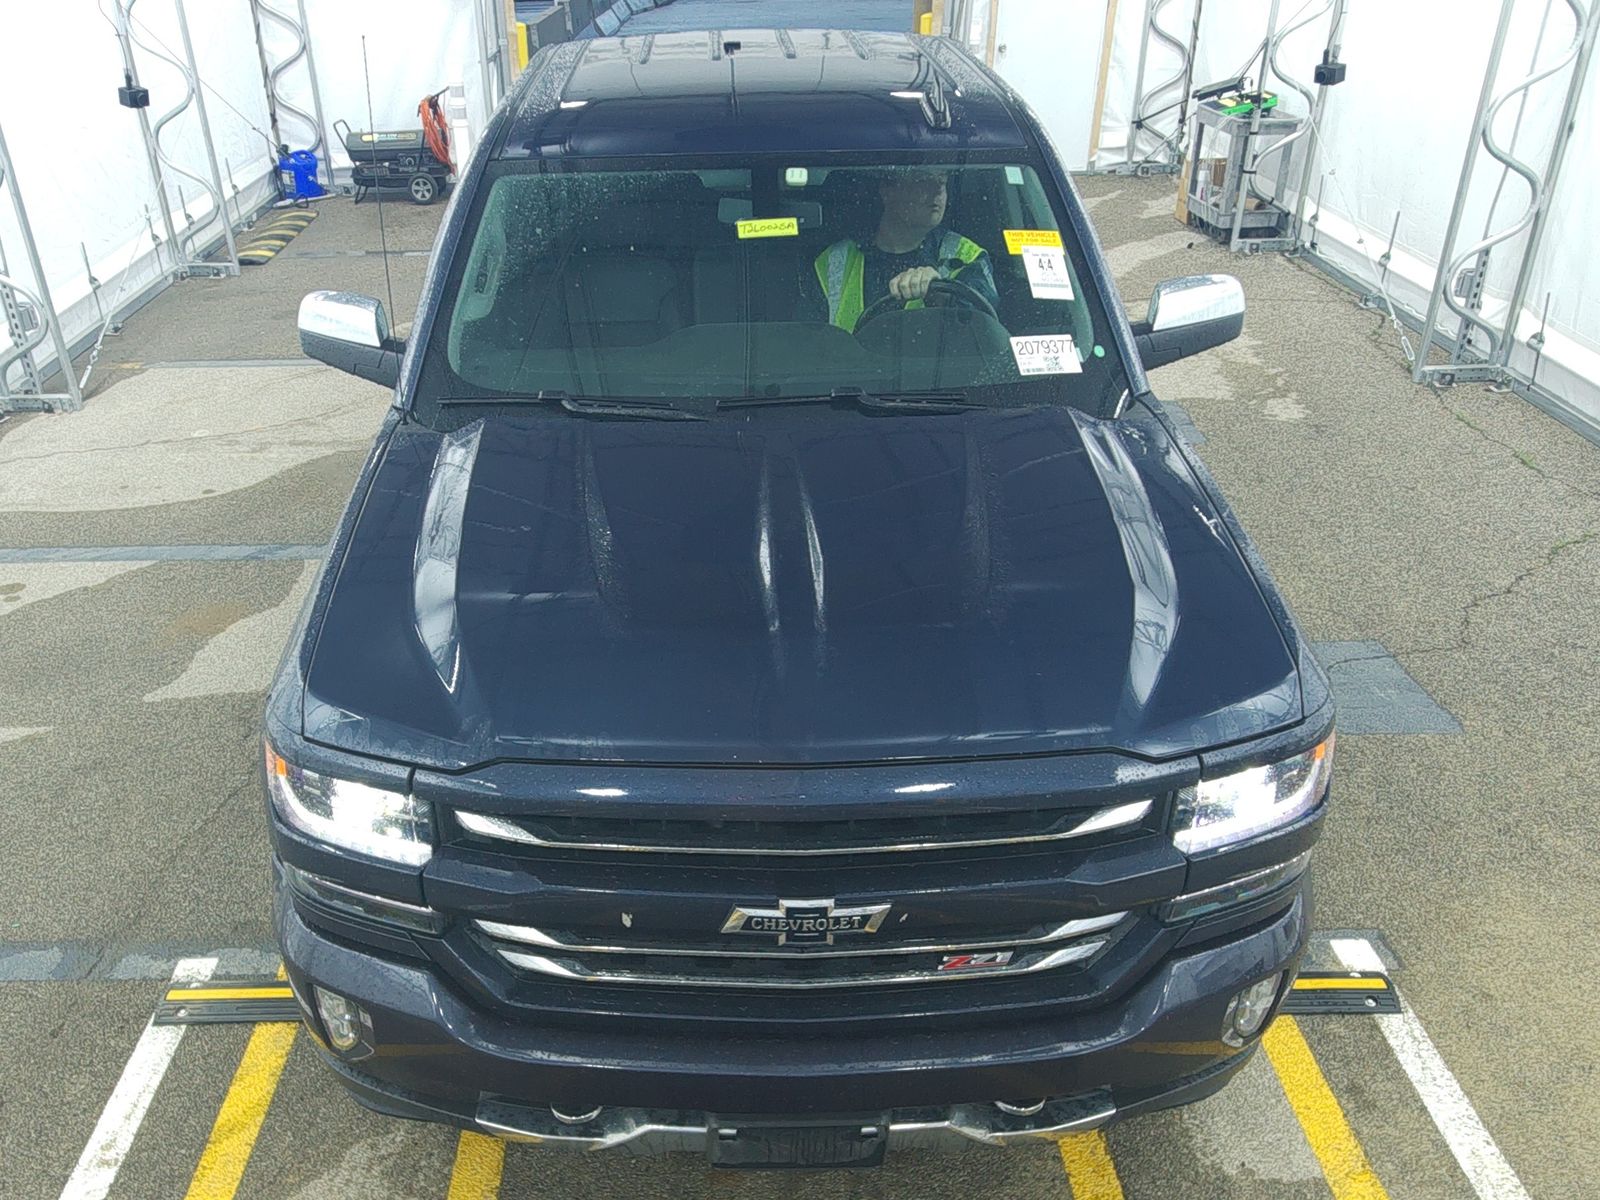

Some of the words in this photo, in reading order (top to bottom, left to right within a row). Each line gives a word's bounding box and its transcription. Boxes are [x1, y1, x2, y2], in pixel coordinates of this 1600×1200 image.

[1016, 339, 1073, 356] 2079377
[750, 916, 863, 931] CHEVROLET
[937, 951, 1014, 971] Z71
